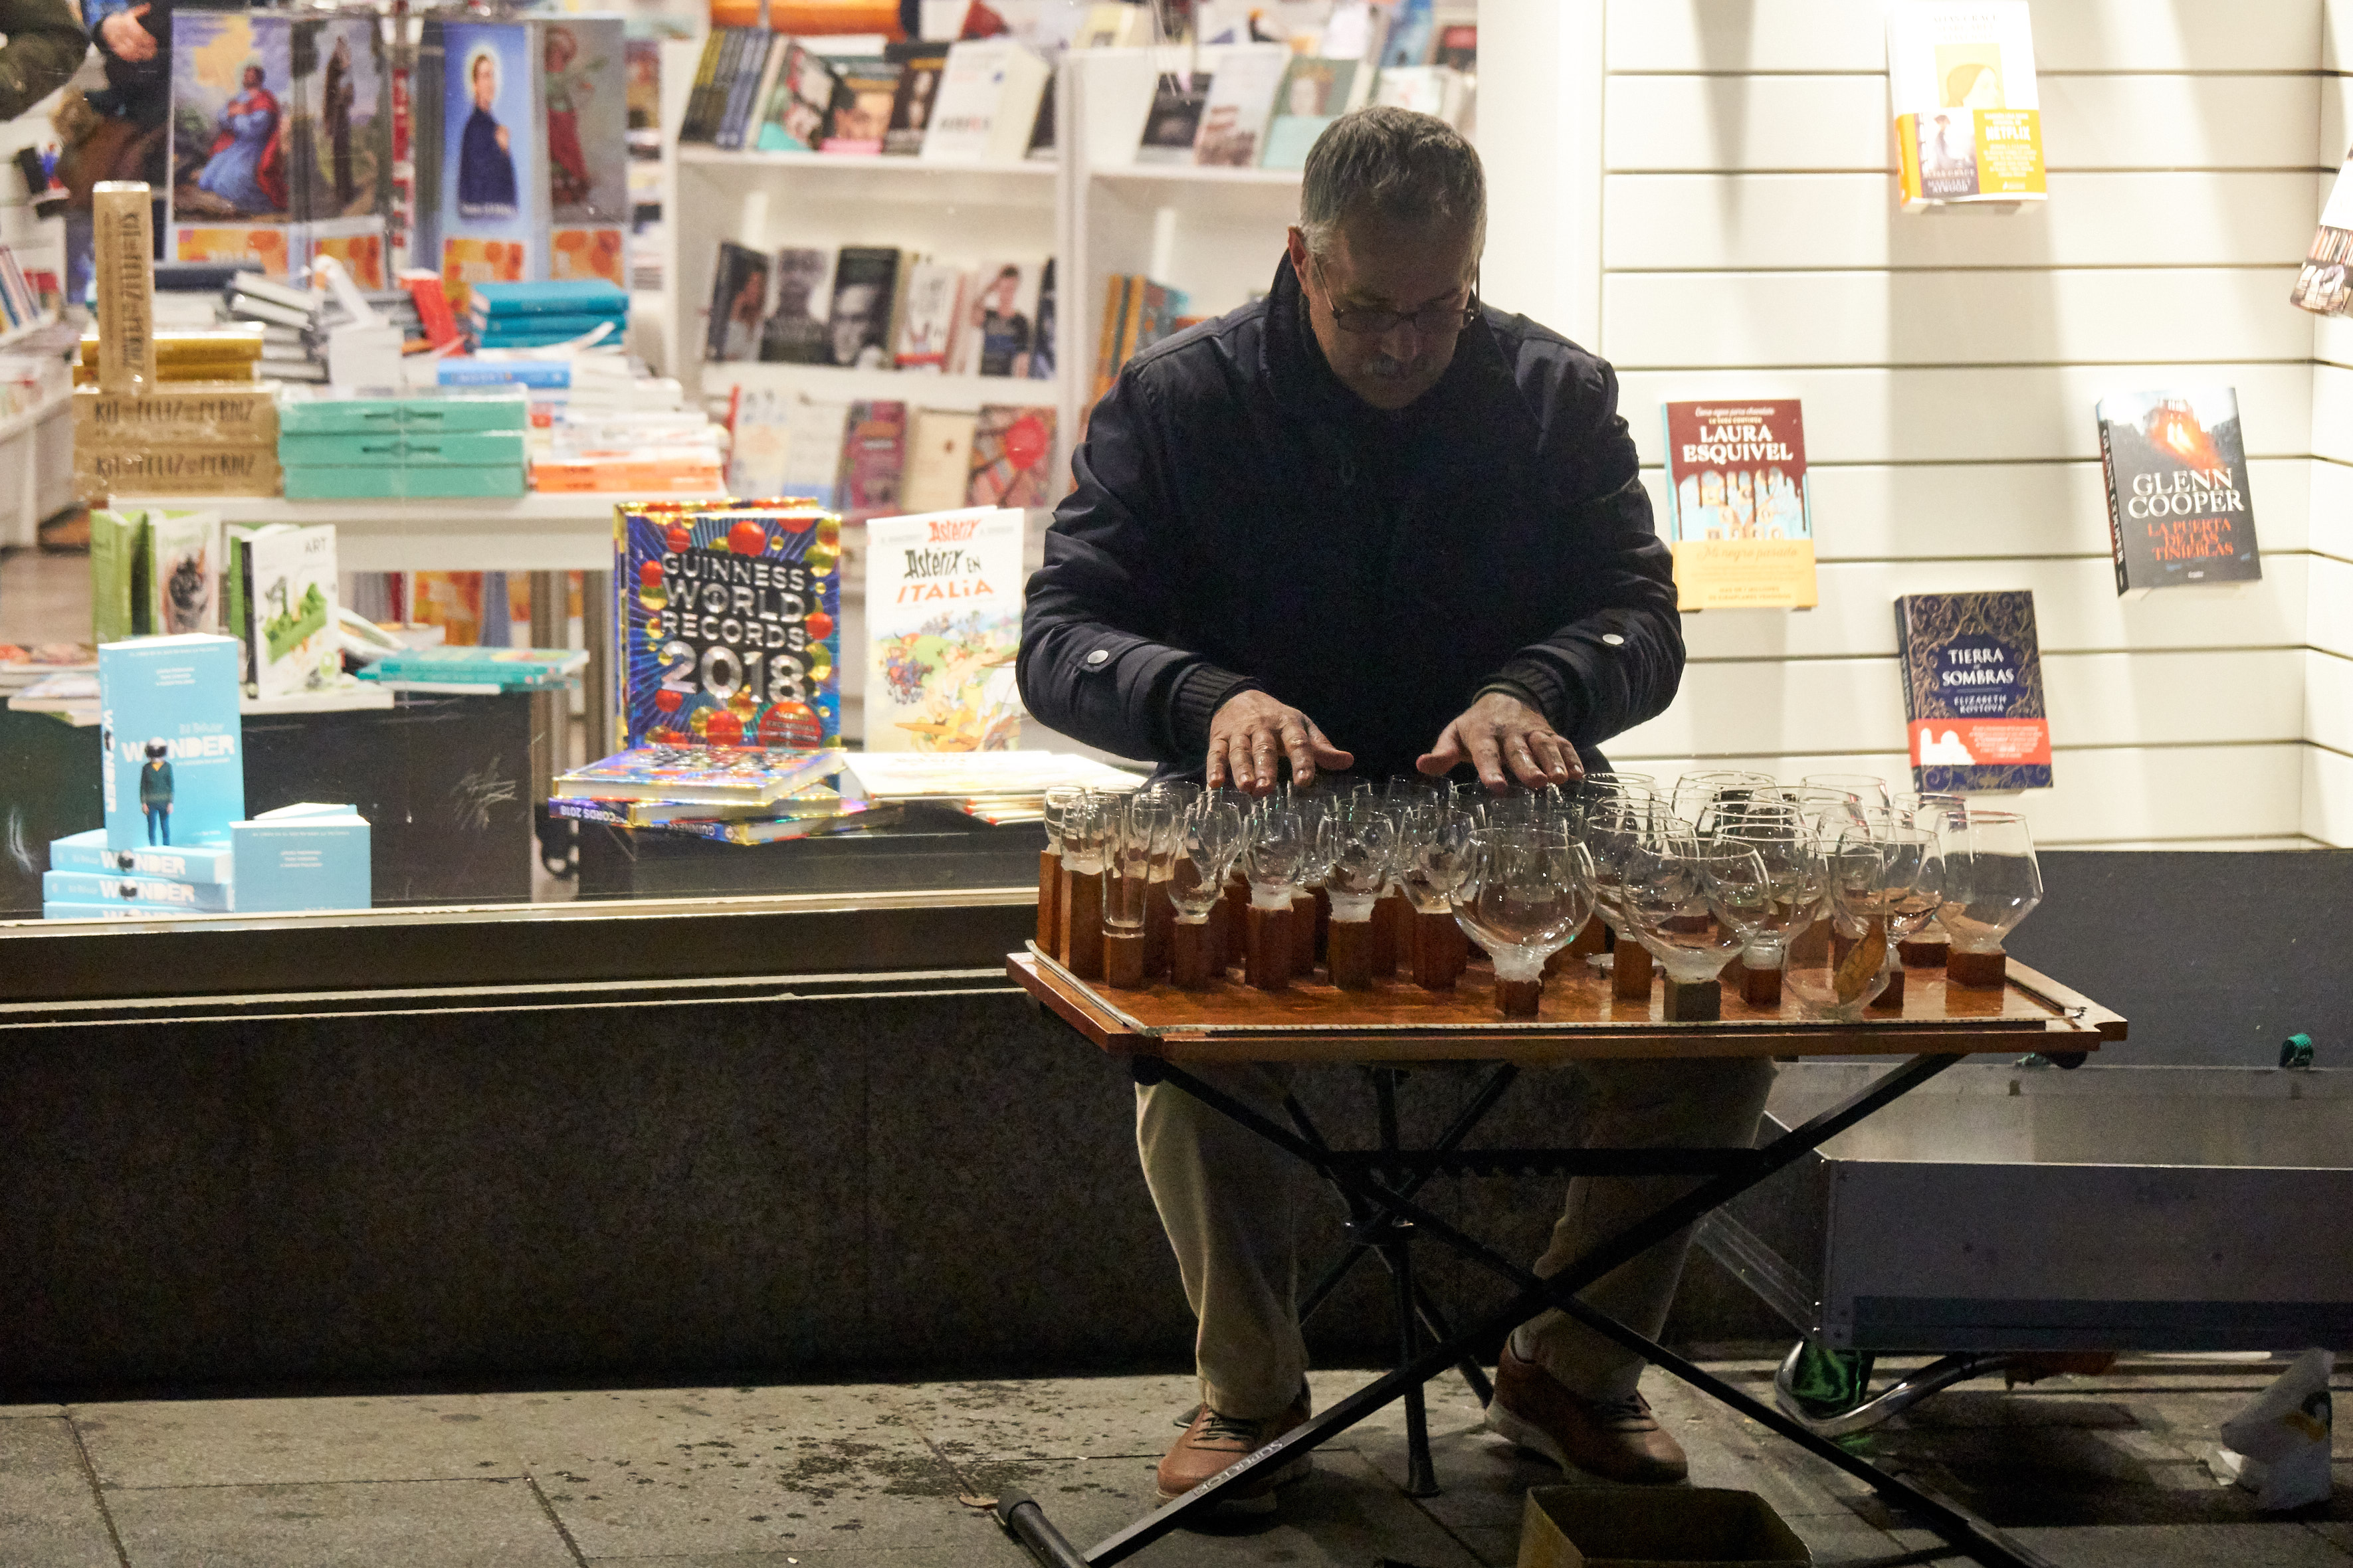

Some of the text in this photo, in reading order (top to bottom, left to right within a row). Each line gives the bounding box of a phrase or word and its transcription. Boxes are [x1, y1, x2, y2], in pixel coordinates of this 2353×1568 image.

[1985, 126, 2031, 141] NETFLIX
[1700, 424, 1773, 442] LAURA
[1683, 442, 1793, 464] ESQUIVEL
[2132, 468, 2233, 496] GLENN
[2102, 429, 2125, 565] GLENN COOPER
[2128, 489, 2245, 518] COOPER
[2147, 518, 2232, 537] LA PUERTA
[304, 537, 328, 553] ART
[2152, 541, 2234, 561] TINIEBLAS
[661, 551, 805, 591] GUINNESS
[966, 555, 982, 573] EN
[661, 577, 806, 623] WORLD
[661, 610, 805, 652] RECORDS
[1948, 647, 2004, 664] TIERRA
[661, 640, 807, 705] 2018
[1942, 667, 2015, 686] SOMBRAS
[1954, 694, 2007, 706] ELIZABETH
[1960, 703, 2005, 714] KOSTOVA
[121, 734, 235, 763] WONDER
[560, 805, 582, 818] 2018
[100, 849, 186, 876] WONDER
[100, 878, 195, 902] WONDER
